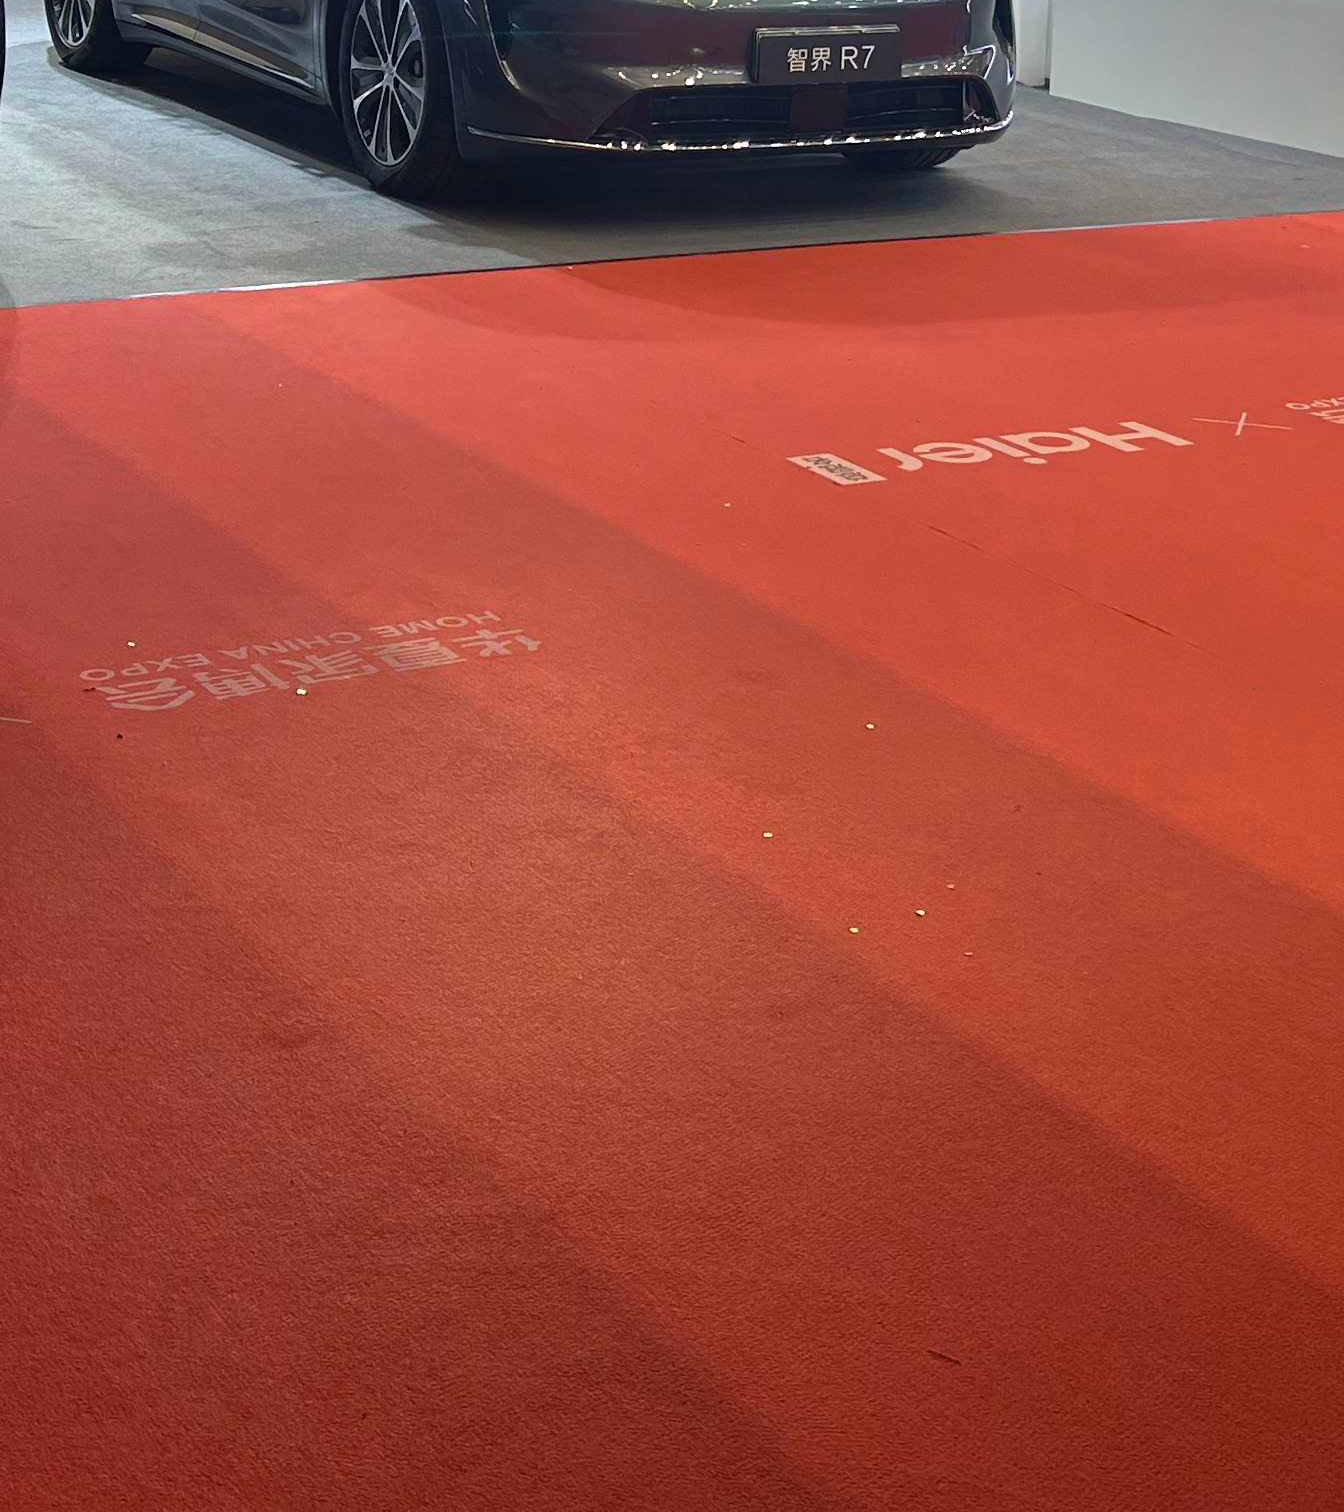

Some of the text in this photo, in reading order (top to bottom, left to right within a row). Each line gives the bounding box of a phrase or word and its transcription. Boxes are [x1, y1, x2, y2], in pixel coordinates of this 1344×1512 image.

[786, 45, 876, 73] 智界 R7
[876, 419, 1194, 473] Haier
[77, 608, 501, 682] HOME CHINA EXPO
[92, 627, 542, 712] 华夏家博会
